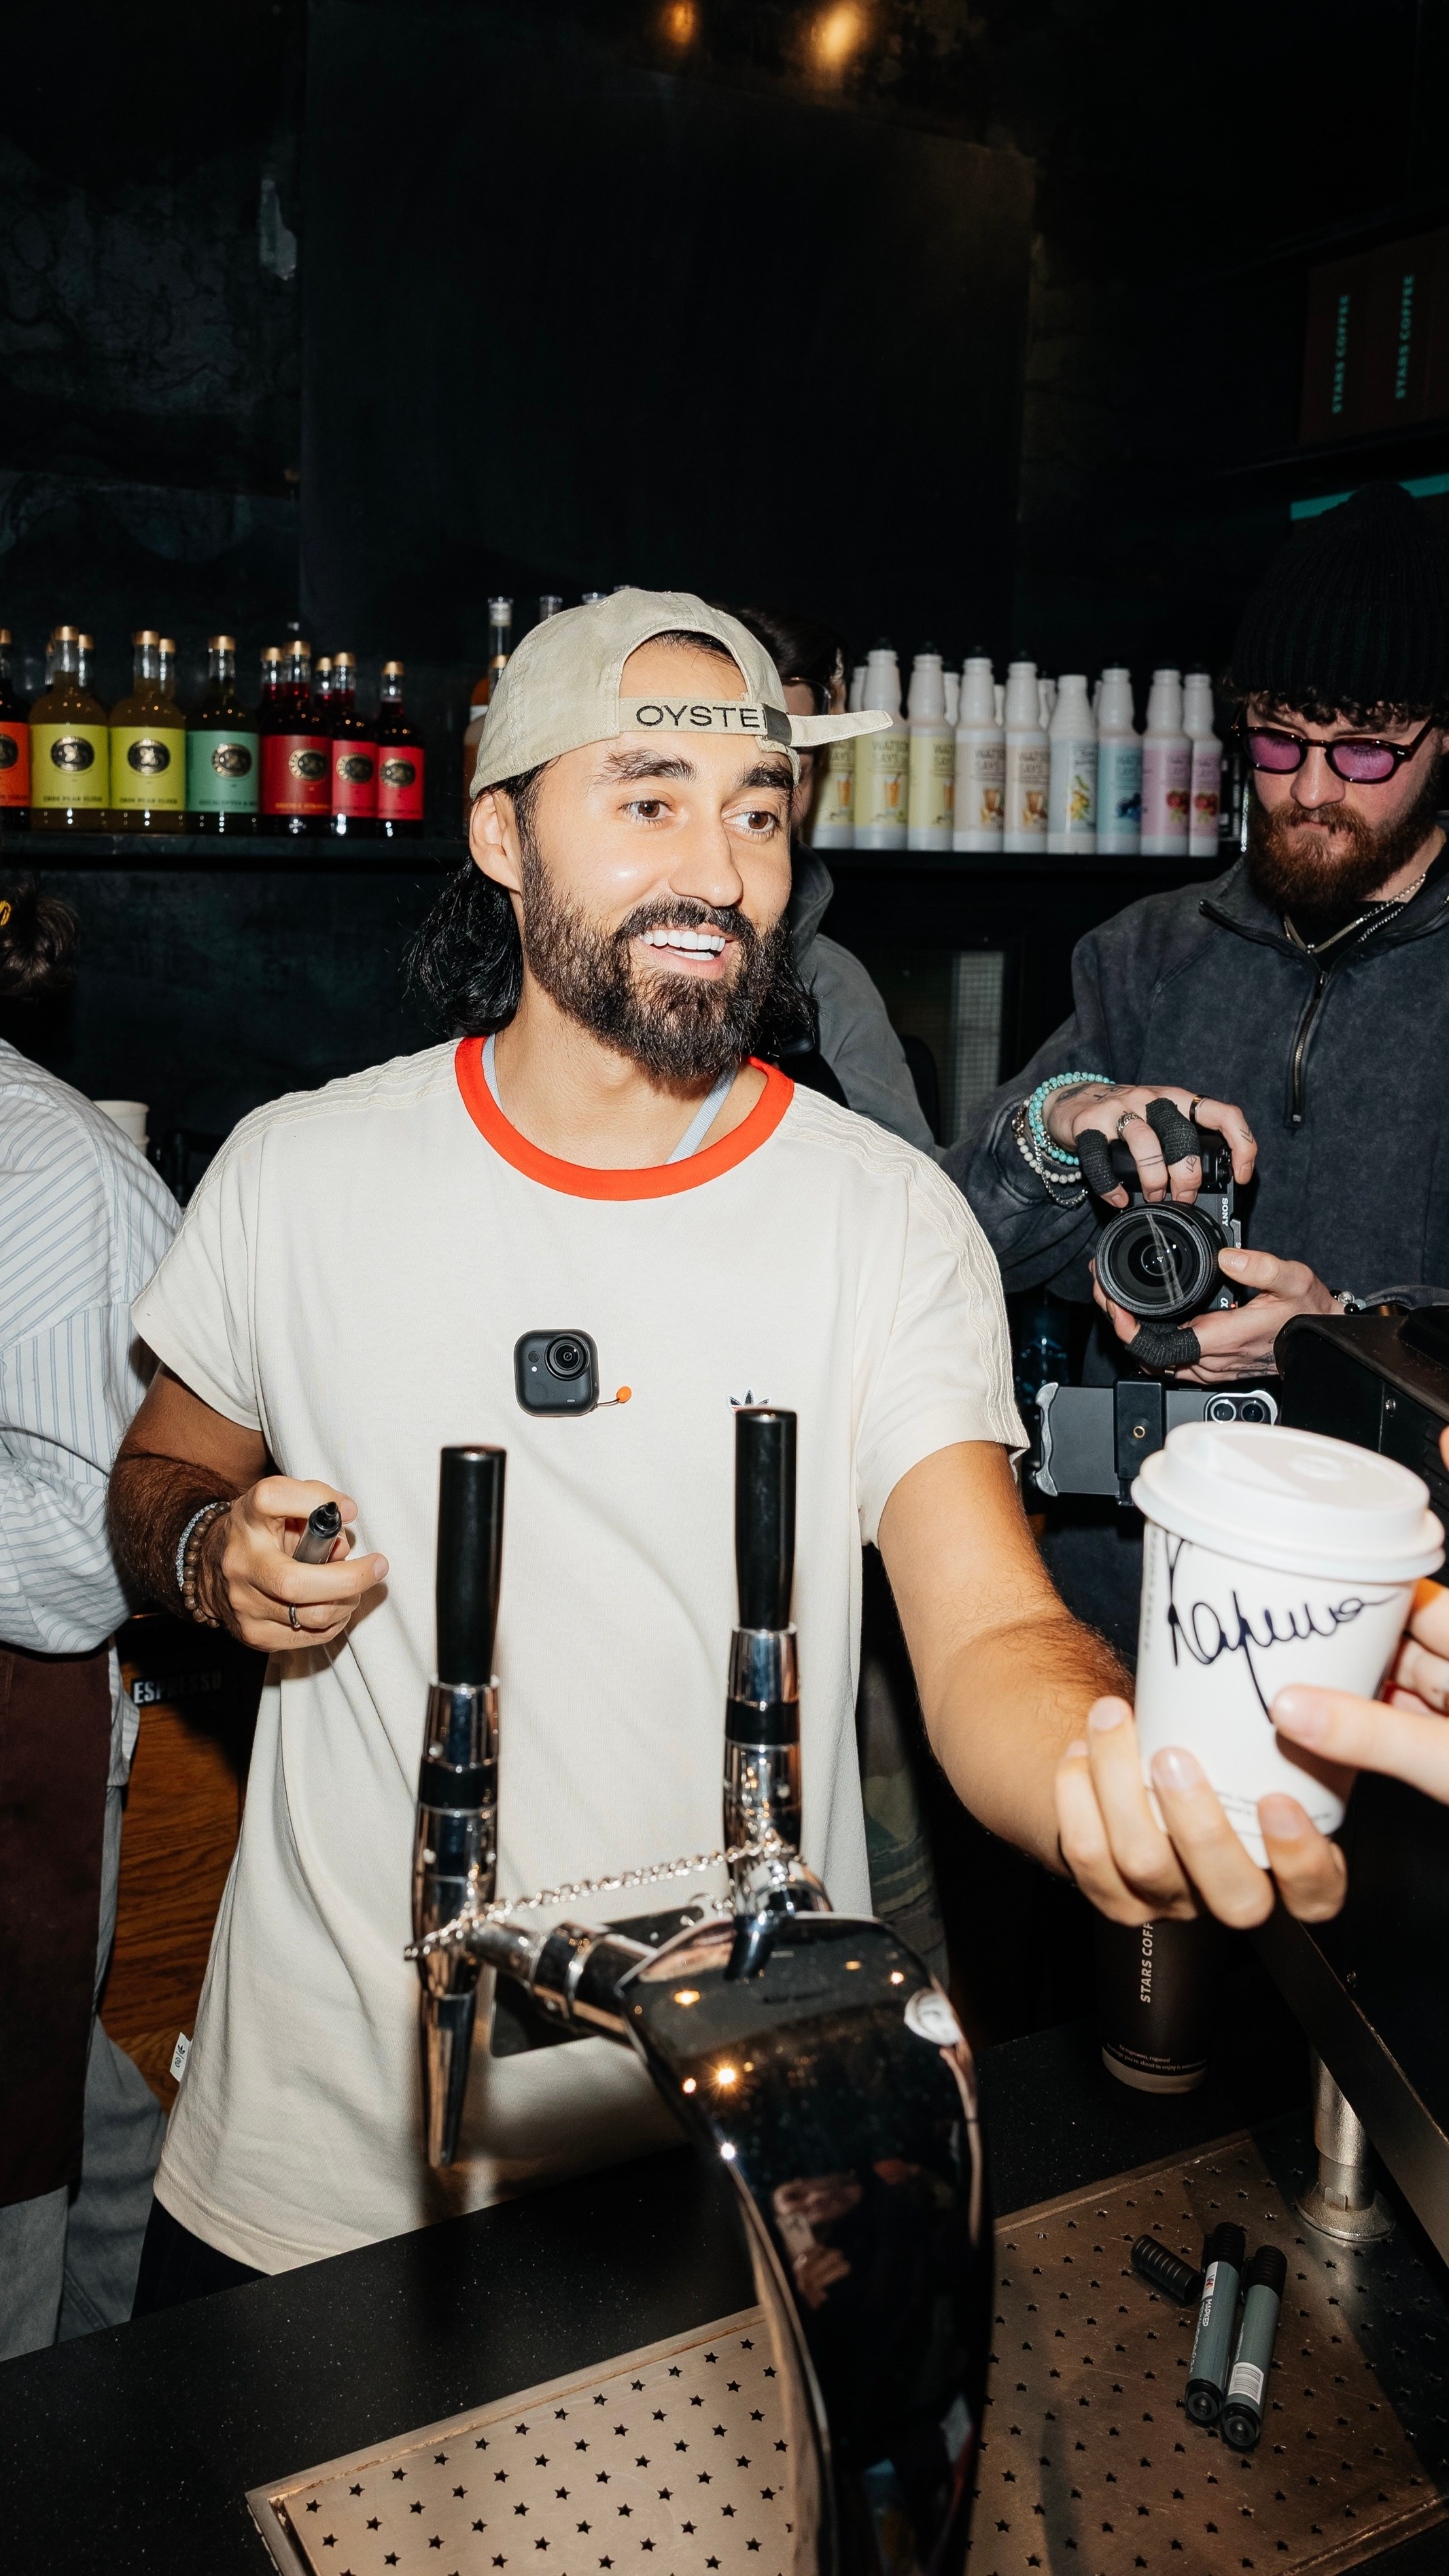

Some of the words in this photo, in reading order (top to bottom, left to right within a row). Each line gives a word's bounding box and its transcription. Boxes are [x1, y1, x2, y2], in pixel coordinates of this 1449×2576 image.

[1335, 294, 1350, 358] COFFEE
[1399, 275, 1414, 341] COFFEE
[1331, 360, 1345, 414] STARS
[1395, 343, 1410, 400] STARS
[636, 705, 767, 729] OYSTE
[1142, 1923, 1153, 1956] COFF
[1140, 1959, 1152, 2003] STARS
[1202, 2299, 1212, 2327] МАРКЕР
